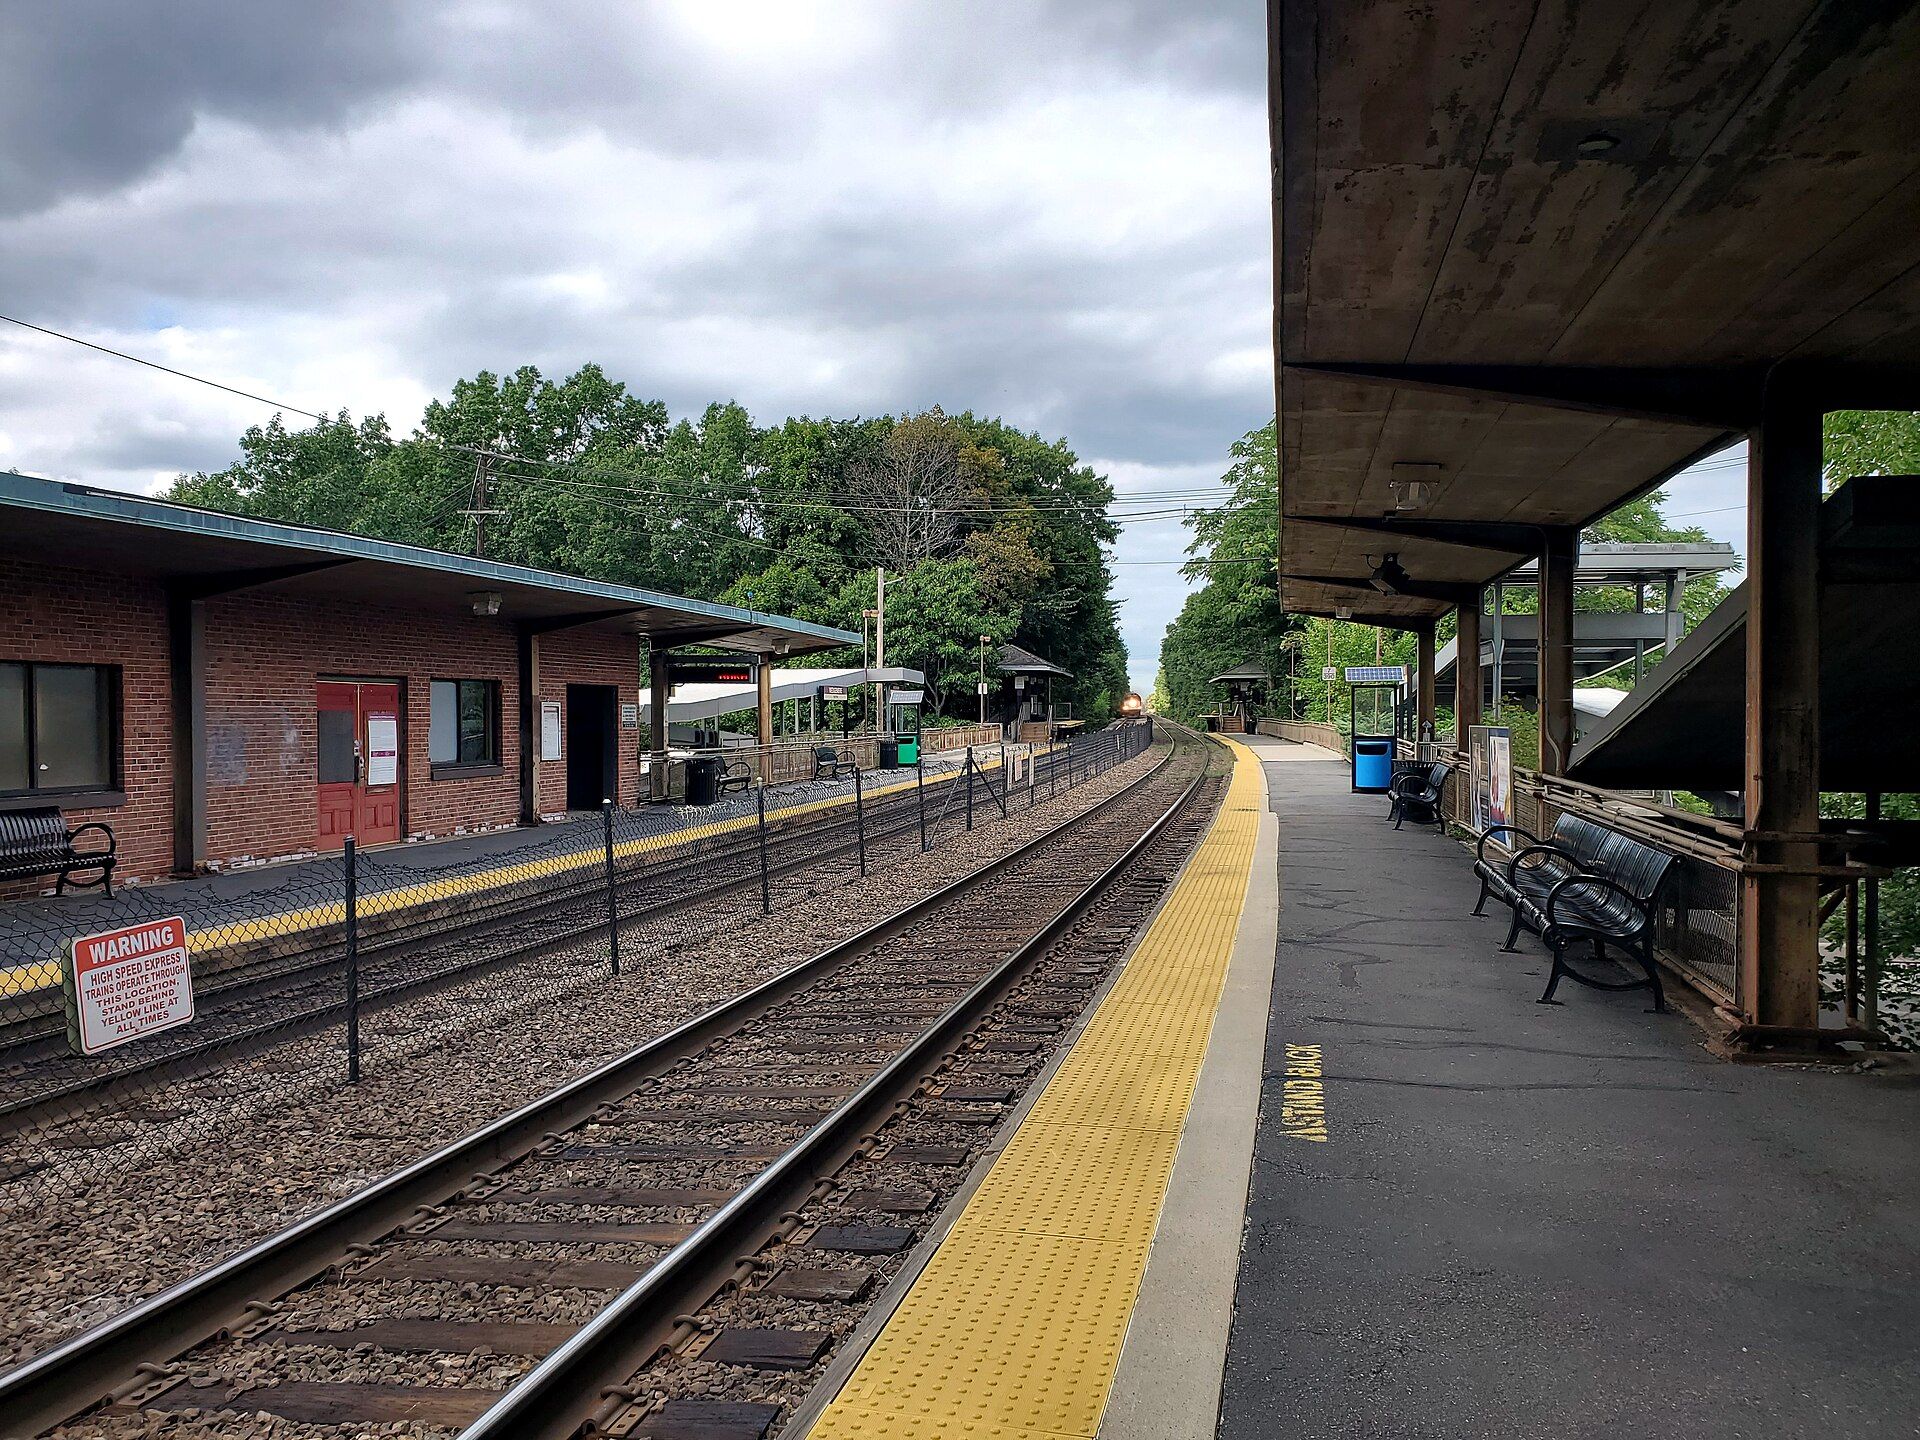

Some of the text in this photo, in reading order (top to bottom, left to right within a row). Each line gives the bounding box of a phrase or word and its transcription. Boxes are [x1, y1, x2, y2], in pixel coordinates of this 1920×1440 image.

[88, 925, 174, 964] WARNING
[85, 964, 186, 1001] TRAINS OPERATE THROUGH
[90, 951, 181, 987] HIGH SPEED EXPRESS
[96, 978, 180, 1008] THIS LOCATION,
[101, 988, 175, 1017] STAND BEHIND
[101, 997, 179, 1028] YELLOW LINE AT
[116, 1010, 170, 1035] ALL TIMES
[1281, 1043, 1326, 1127] STAND BACK
